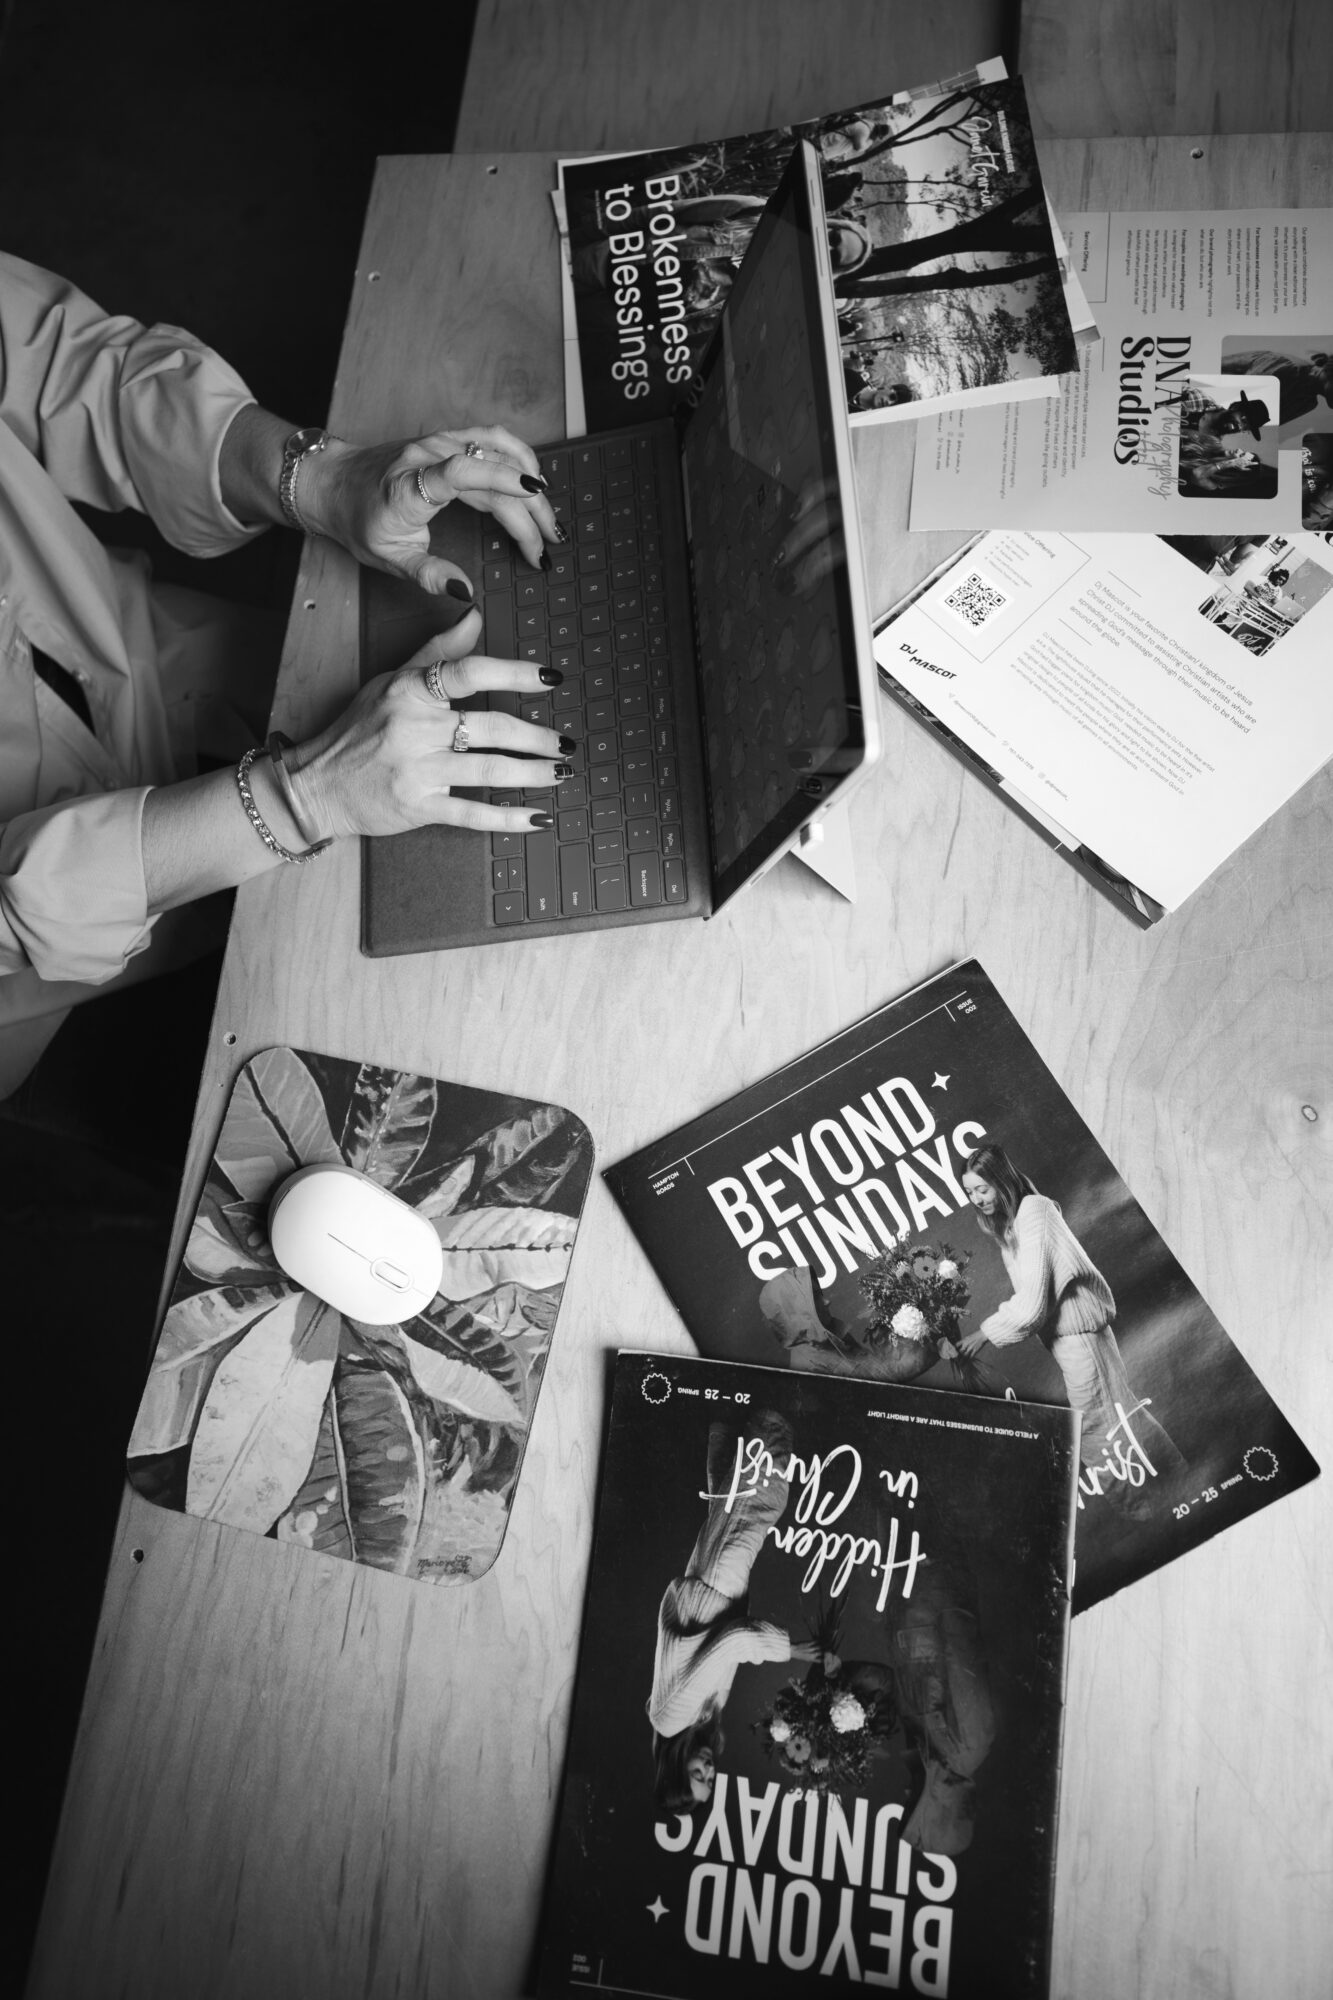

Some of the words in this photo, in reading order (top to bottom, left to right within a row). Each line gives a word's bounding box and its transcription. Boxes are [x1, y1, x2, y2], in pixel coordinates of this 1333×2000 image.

[960, 116, 1000, 165] Janet
[967, 160, 999, 207] Garcia
[605, 183, 634, 221] to
[645, 174, 692, 384] Brokenness
[609, 231, 654, 400] Blessings
[1063, 376, 1071, 395] through
[1154, 335, 1191, 410] DNA
[1114, 336, 1155, 465] Studios
[1043, 407, 1051, 427] through
[1147, 404, 1189, 499] Photography
[585, 523, 593, 531] W
[1023, 530, 1035, 540] vice
[1032, 538, 1057, 559] Offering
[1068, 604, 1093, 625] around
[1090, 620, 1104, 634] the
[899, 642, 918, 656] DJ
[1085, 588, 1106, 606] Christ
[1103, 602, 1115, 614] DJ
[1112, 609, 1149, 640] committed
[1146, 636, 1156, 645] to
[1152, 641, 1183, 668] assisting
[1180, 663, 1211, 689] Christian
[1209, 685, 1231, 704] artists
[1229, 701, 1246, 716] who
[1244, 712, 1257, 725] are
[1101, 586, 1126, 607] Mascot
[1123, 603, 1132, 612] is
[1129, 609, 1145, 624] your
[1143, 619, 1169, 641] favorite
[1197, 661, 1227, 687] kingdom
[1225, 682, 1235, 692] of
[1232, 688, 1254, 707] Jesus
[908, 655, 957, 680] MASCOT
[1076, 596, 1109, 624] spreading
[1106, 619, 1127, 637] God's
[1123, 634, 1154, 660] message
[1151, 654, 1179, 678] through
[1176, 673, 1194, 689] their
[1191, 686, 1213, 705] music
[1211, 702, 1221, 712] to
[1219, 707, 1231, 719] be
[1228, 715, 1251, 734] heard
[531, 710, 538, 719] M
[640, 869, 648, 896] Backspace
[956, 998, 973, 1010] ISSUE
[964, 1004, 977, 1014] 002
[707, 1077, 935, 1248] BEYOND
[652, 1170, 679, 1190] HAMPTON
[655, 1181, 675, 1196] ROADS
[677, 1386, 699, 1395] SPRING
[703, 1388, 719, 1400] 25
[734, 1391, 750, 1404] 20
[867, 1410, 885, 1418] LIGHT
[886, 1412, 909, 1421] BRIGHT
[915, 1416, 928, 1424] ARE
[929, 1418, 945, 1426] THAT
[945, 1420, 983, 1431] BUSINESSES
[994, 1427, 1014, 1435] GUIDE
[1014, 1429, 1032, 1438] FIELD
[1078, 1398, 1157, 1509] rist
[699, 1437, 861, 1525] Christ
[880, 1470, 918, 1510] in
[1171, 1501, 1191, 1520] 20
[1200, 1485, 1219, 1503] 25
[1219, 1472, 1243, 1491] SPRING
[767, 1517, 926, 1612] Hidden
[685, 1862, 953, 1999] BEYOND
